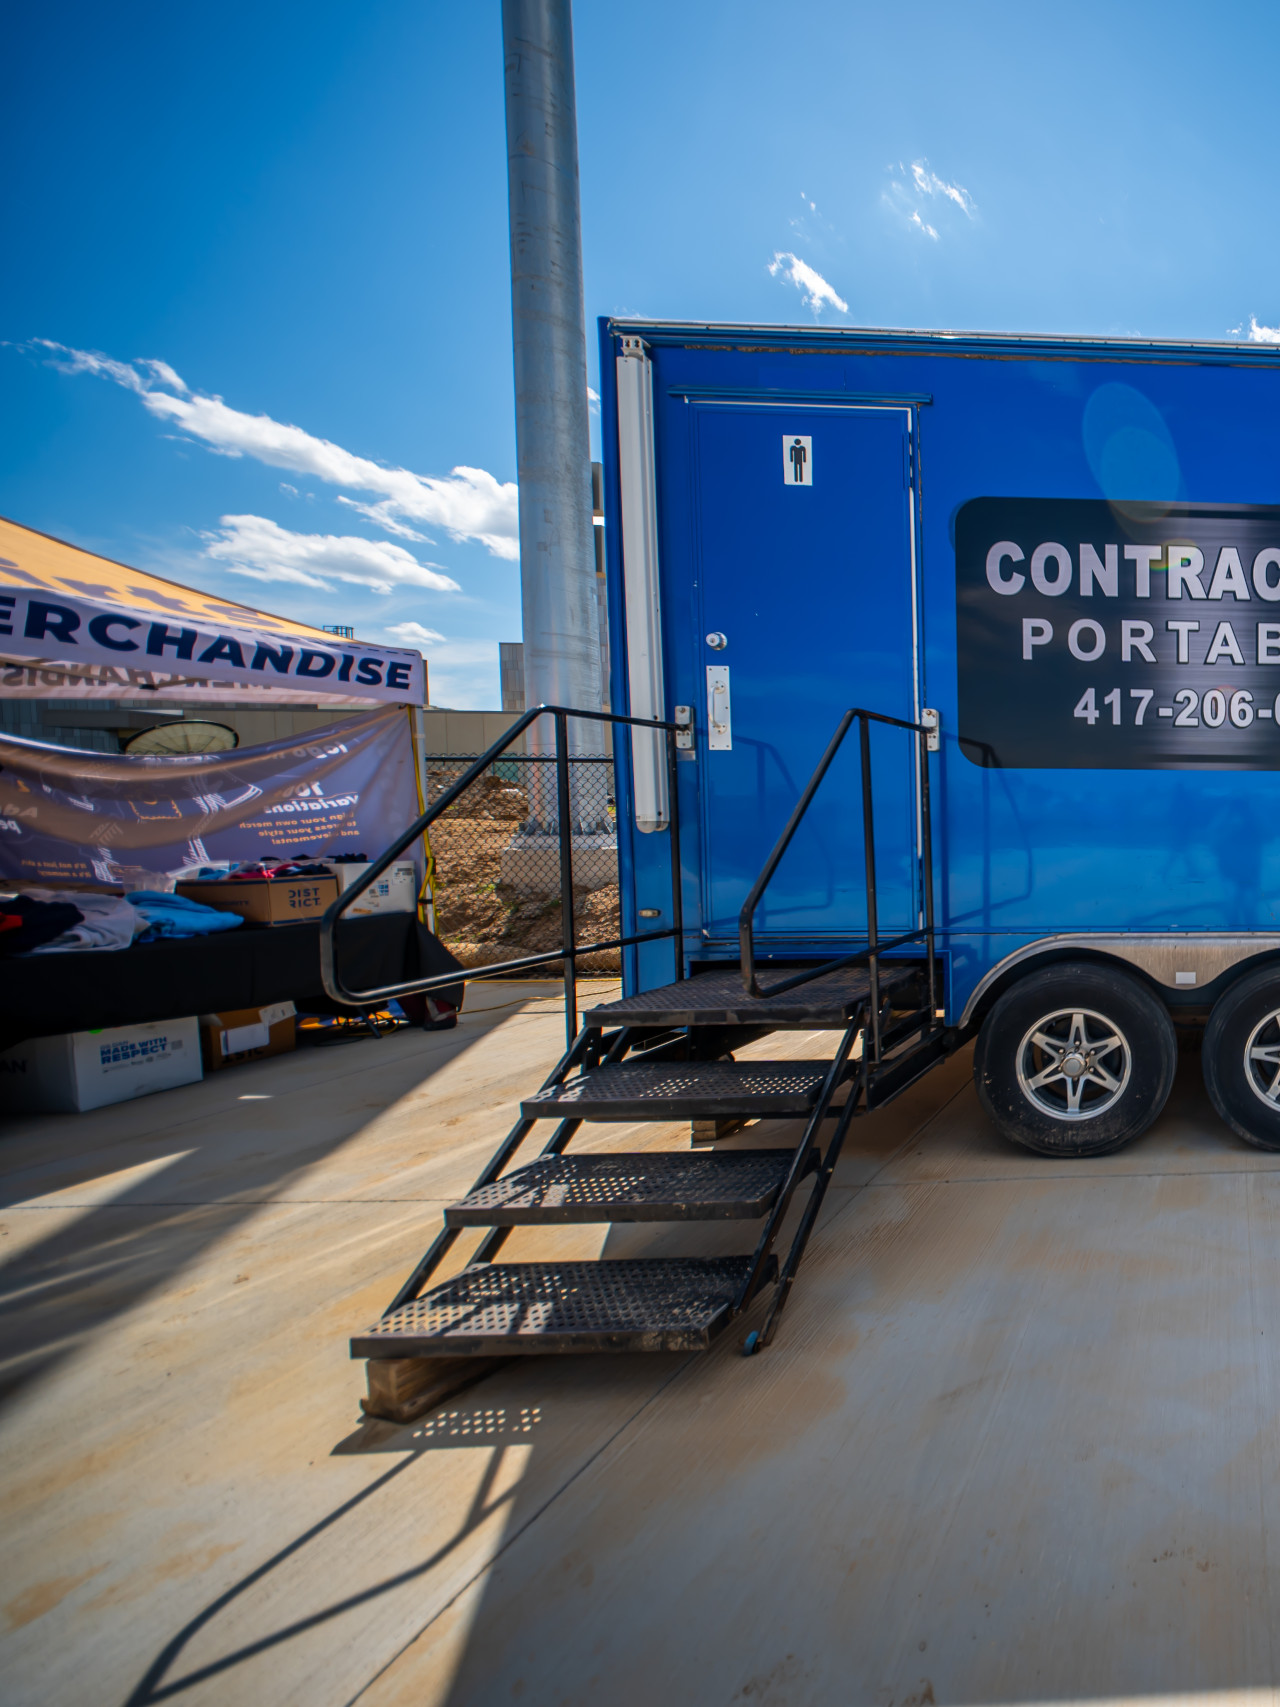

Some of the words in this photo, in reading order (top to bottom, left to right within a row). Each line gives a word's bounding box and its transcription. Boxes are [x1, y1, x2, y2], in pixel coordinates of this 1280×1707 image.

[100, 1043, 127, 1057] MADE
[138, 1036, 168, 1048] WITH
[101, 1042, 168, 1065] RESPECT
